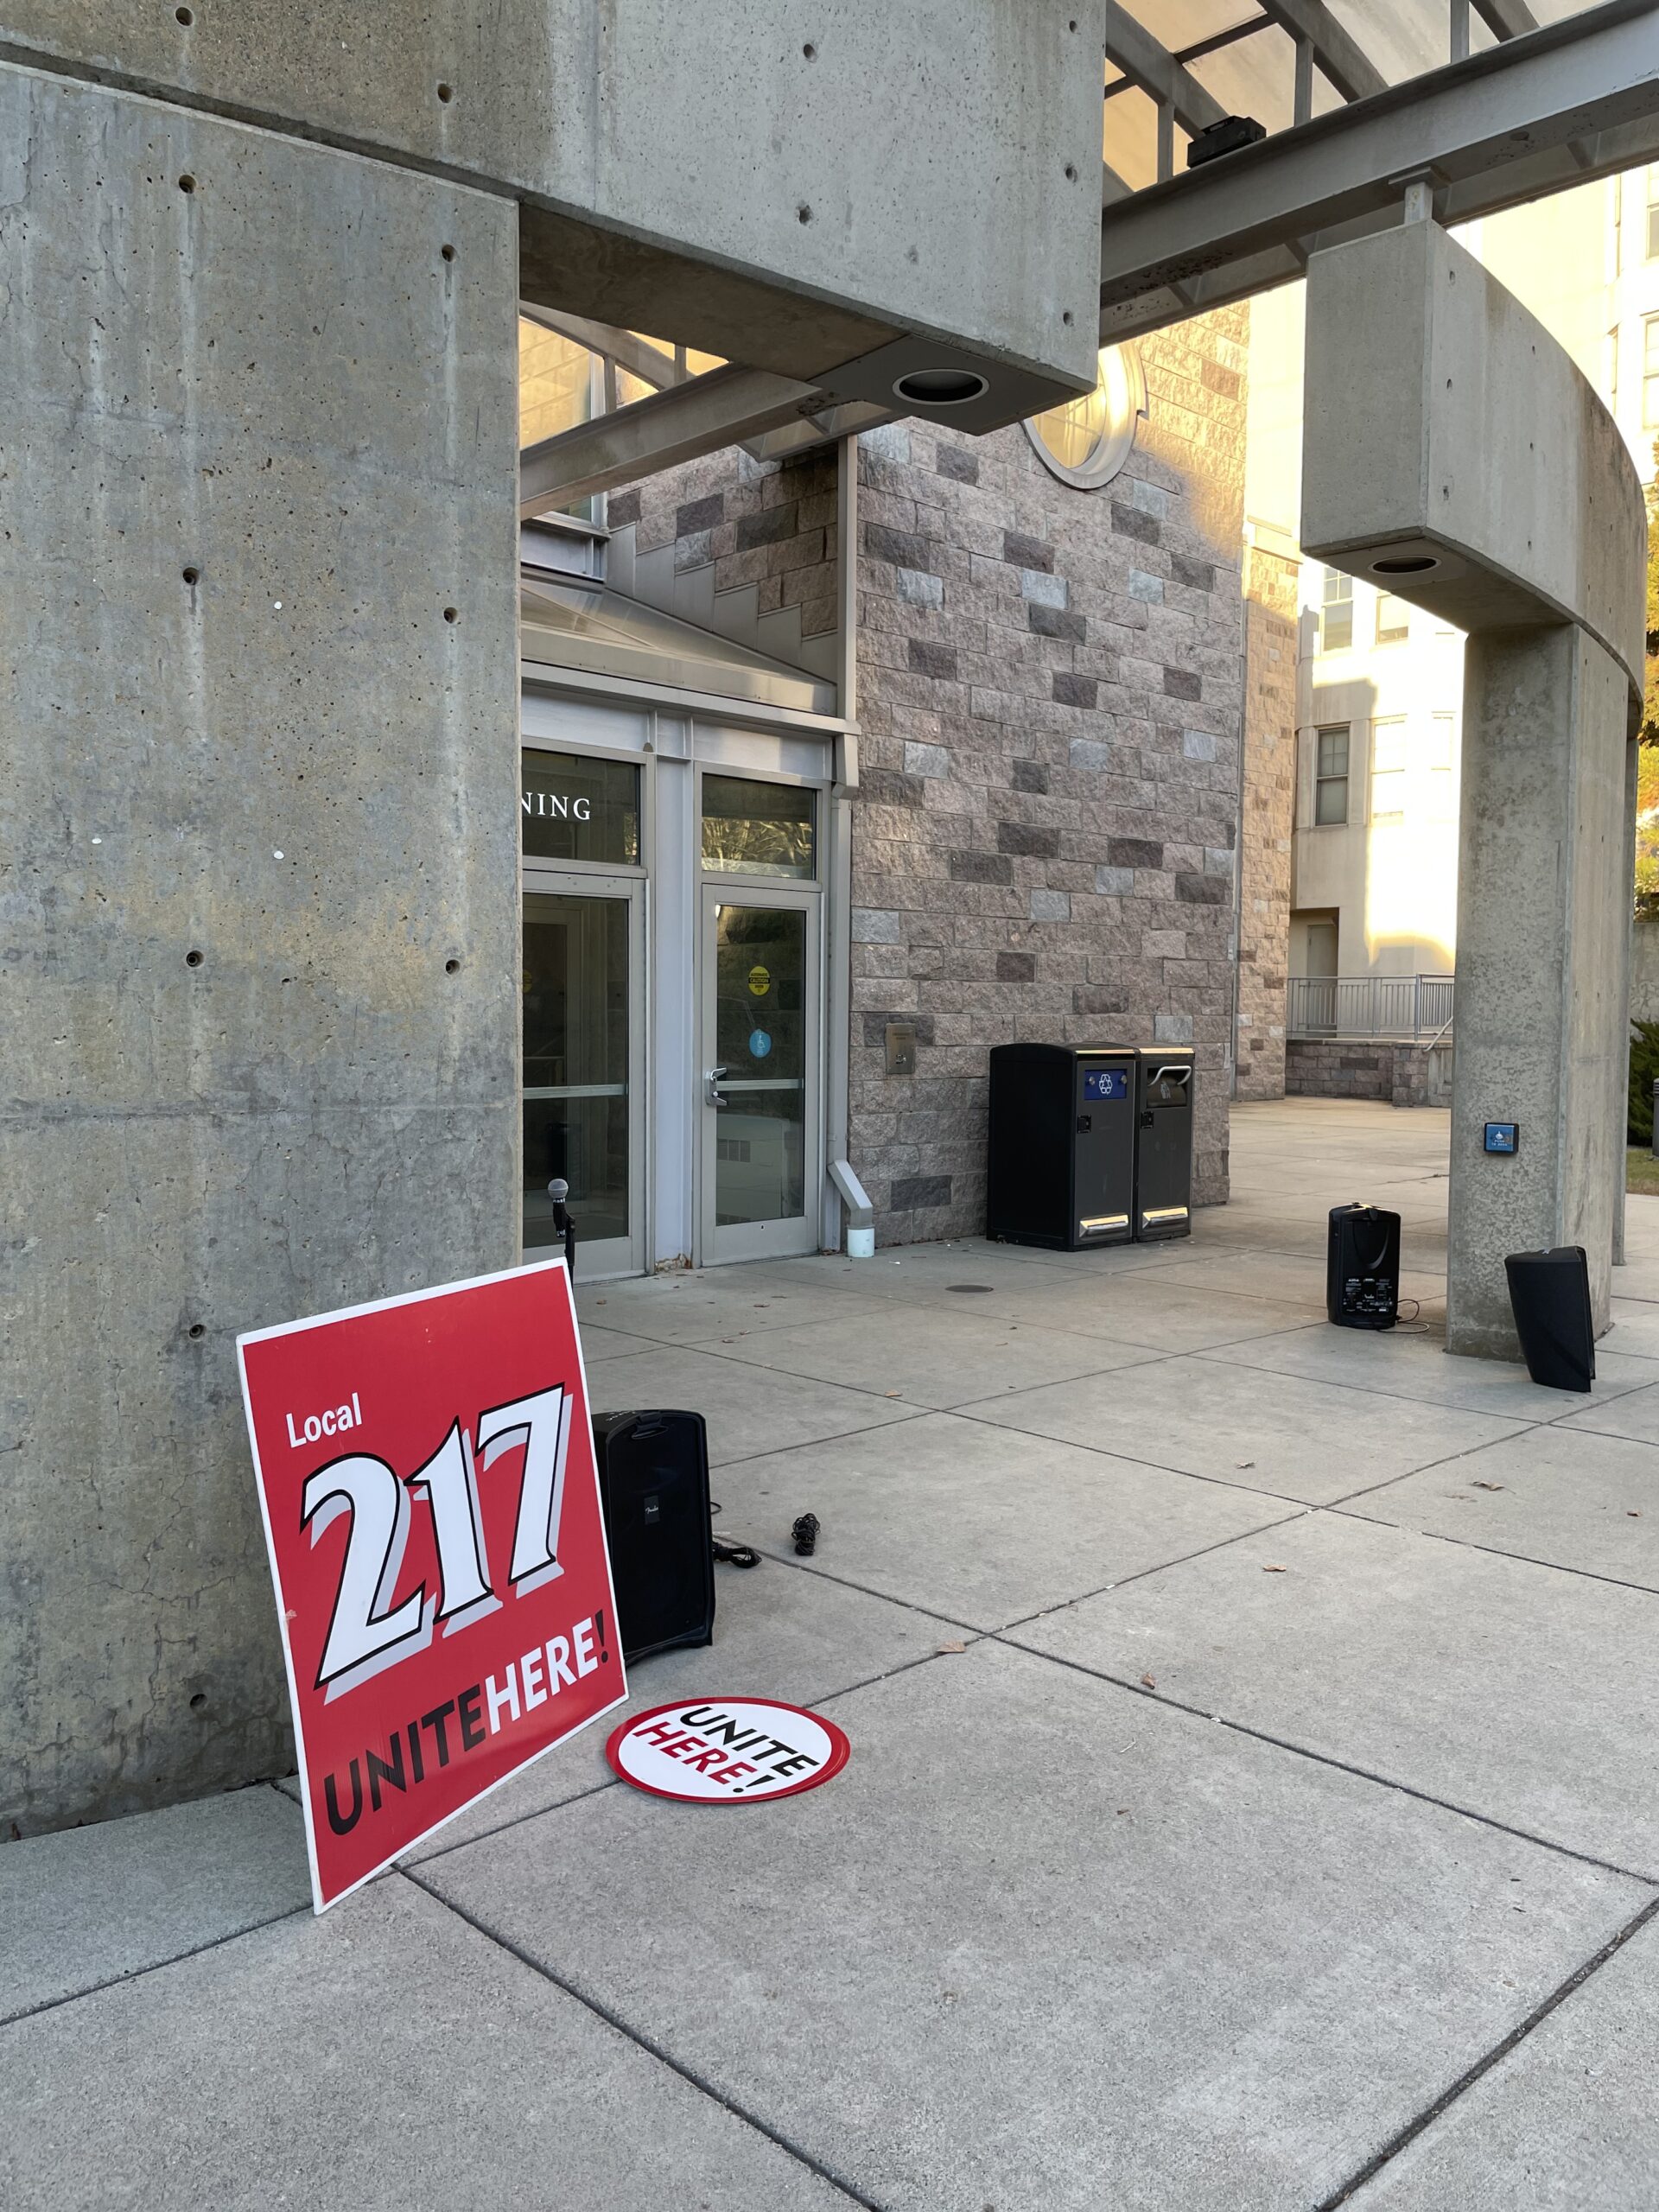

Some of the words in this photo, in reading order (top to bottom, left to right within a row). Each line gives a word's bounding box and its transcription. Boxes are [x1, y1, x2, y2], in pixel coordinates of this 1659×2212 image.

[285, 1393, 363, 1448] Local
[299, 1382, 570, 1700] 217
[632, 1721, 777, 1793] HERE!
[679, 1706, 821, 1777] UNITE
